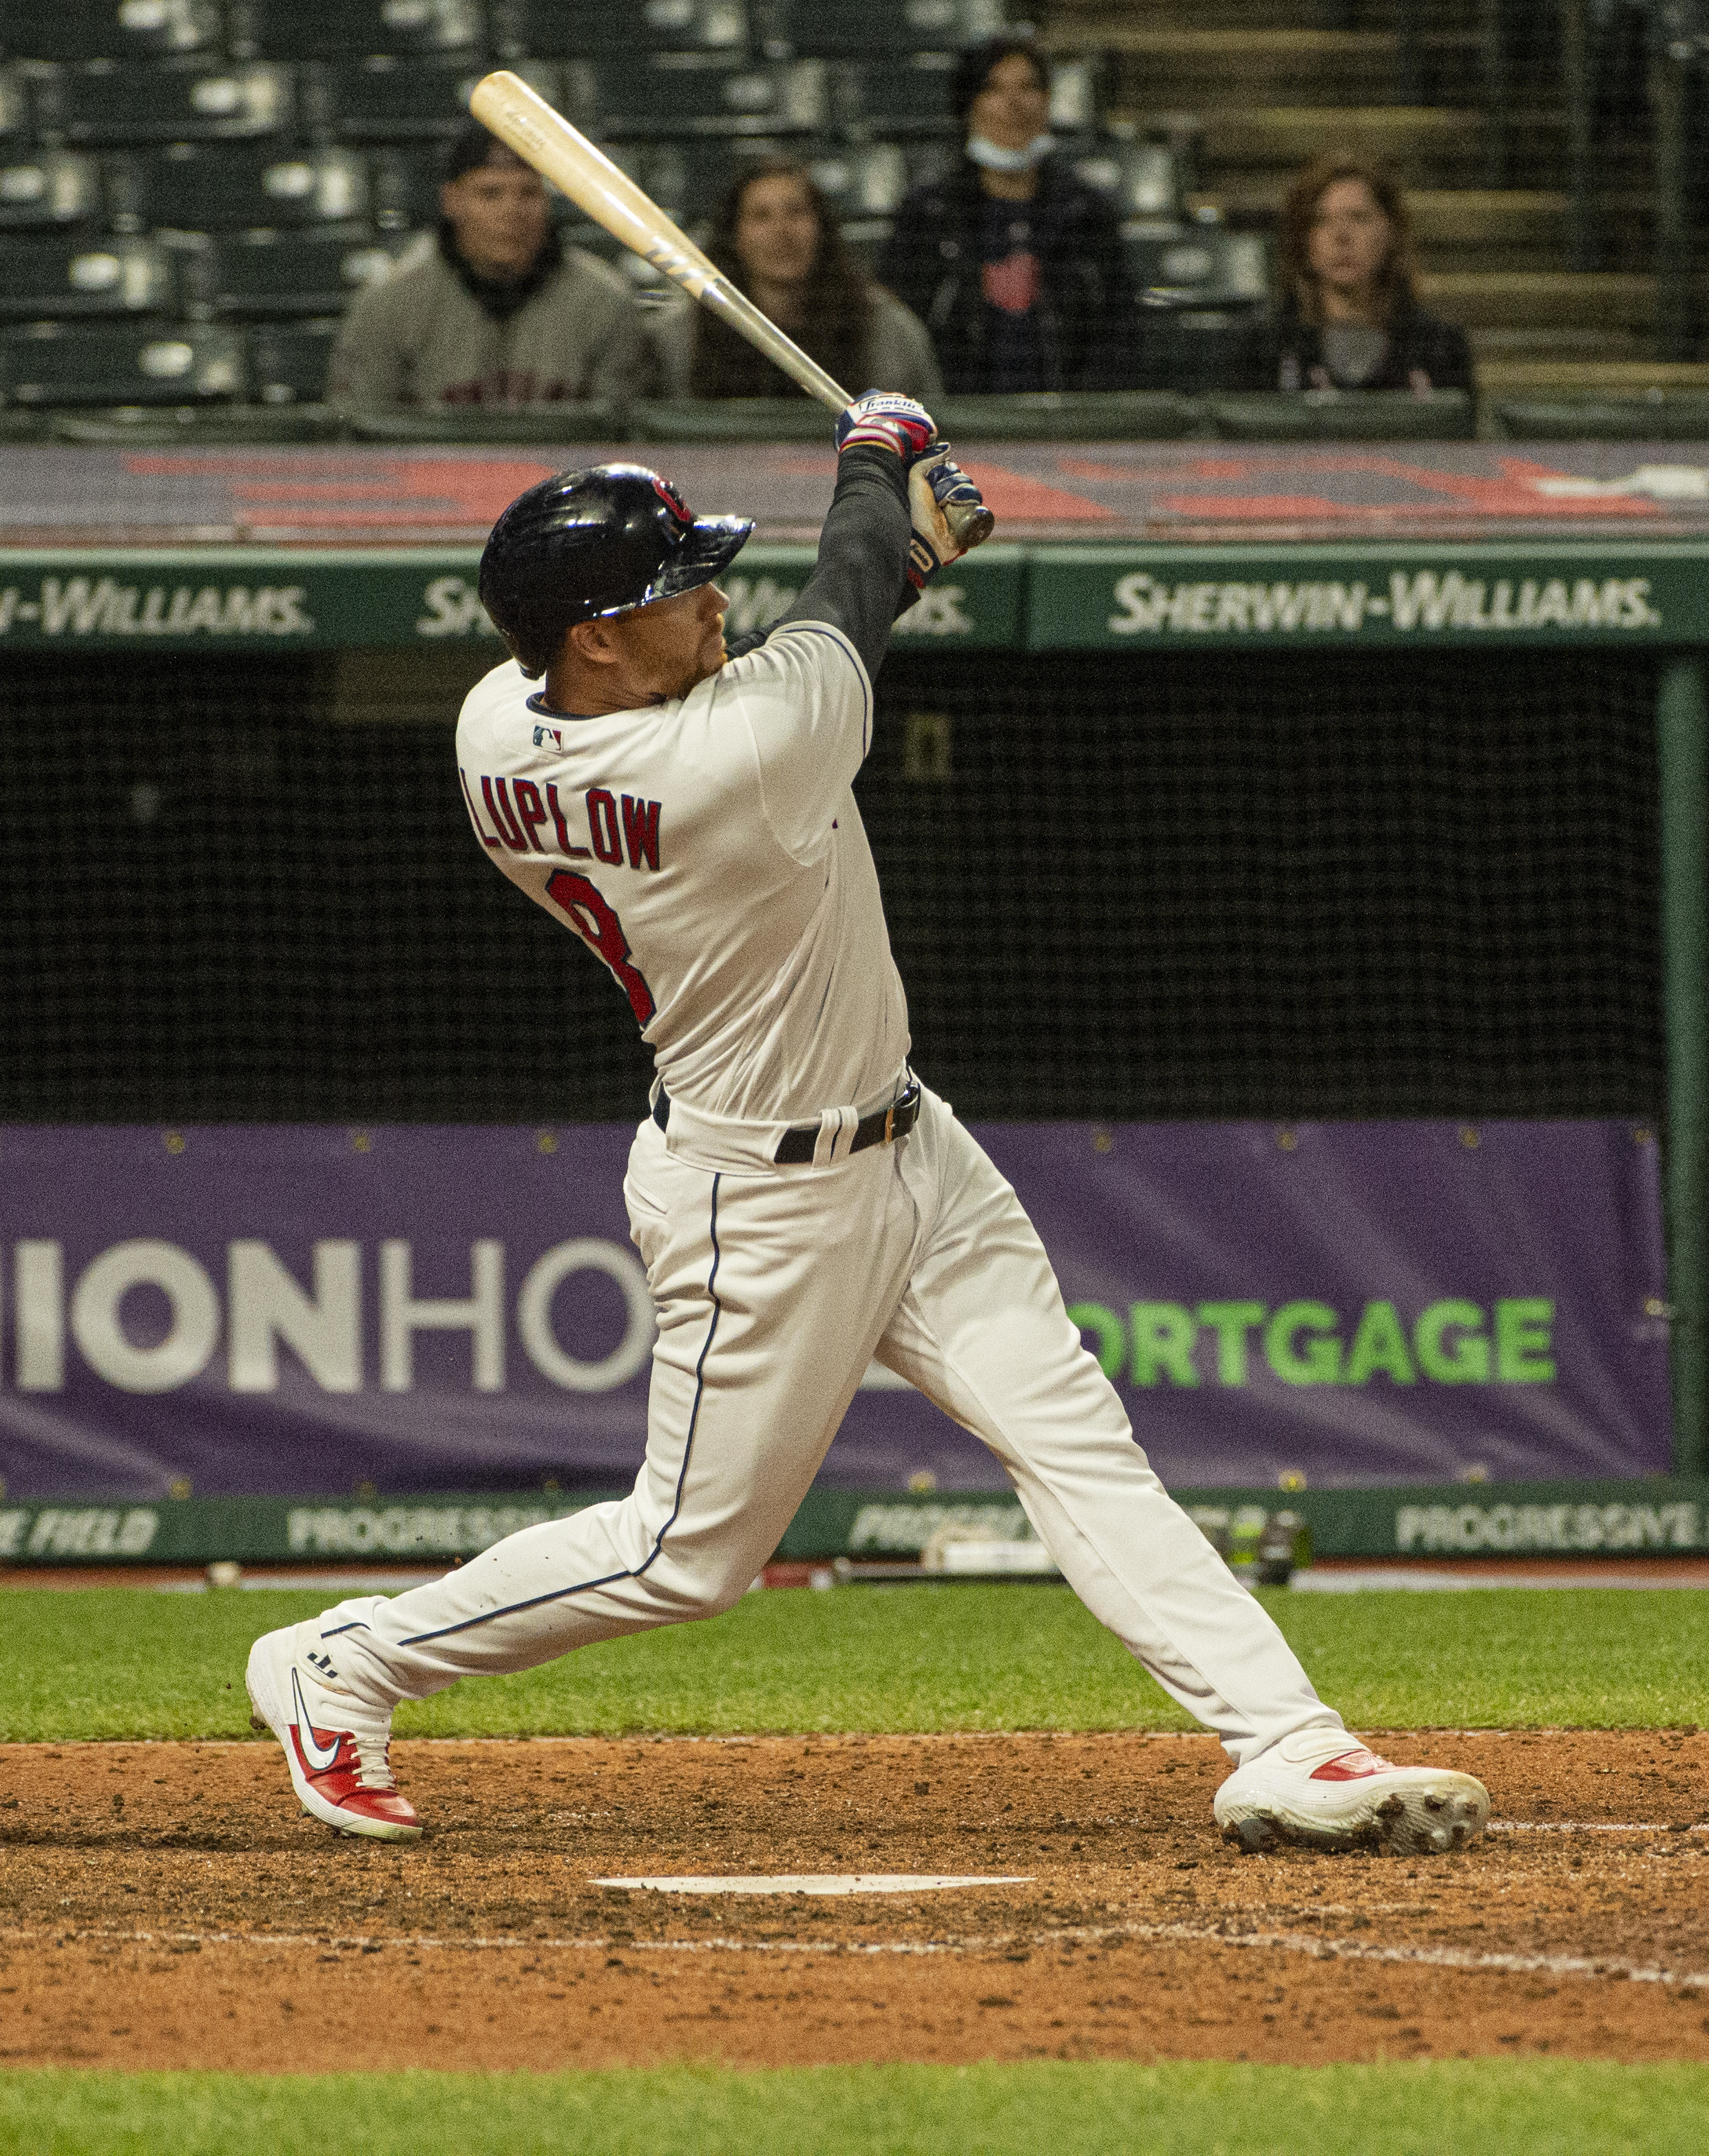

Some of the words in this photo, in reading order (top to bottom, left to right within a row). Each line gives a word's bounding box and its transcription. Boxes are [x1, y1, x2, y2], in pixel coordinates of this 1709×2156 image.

[459, 767, 662, 871] LUPLOW
[544, 868, 658, 1028] 8
[0, 1238, 658, 1394] IONHO
[1067, 1298, 1555, 1386] ORTGAGE
[1396, 1503, 1702, 1550] PROGRESSIVE
